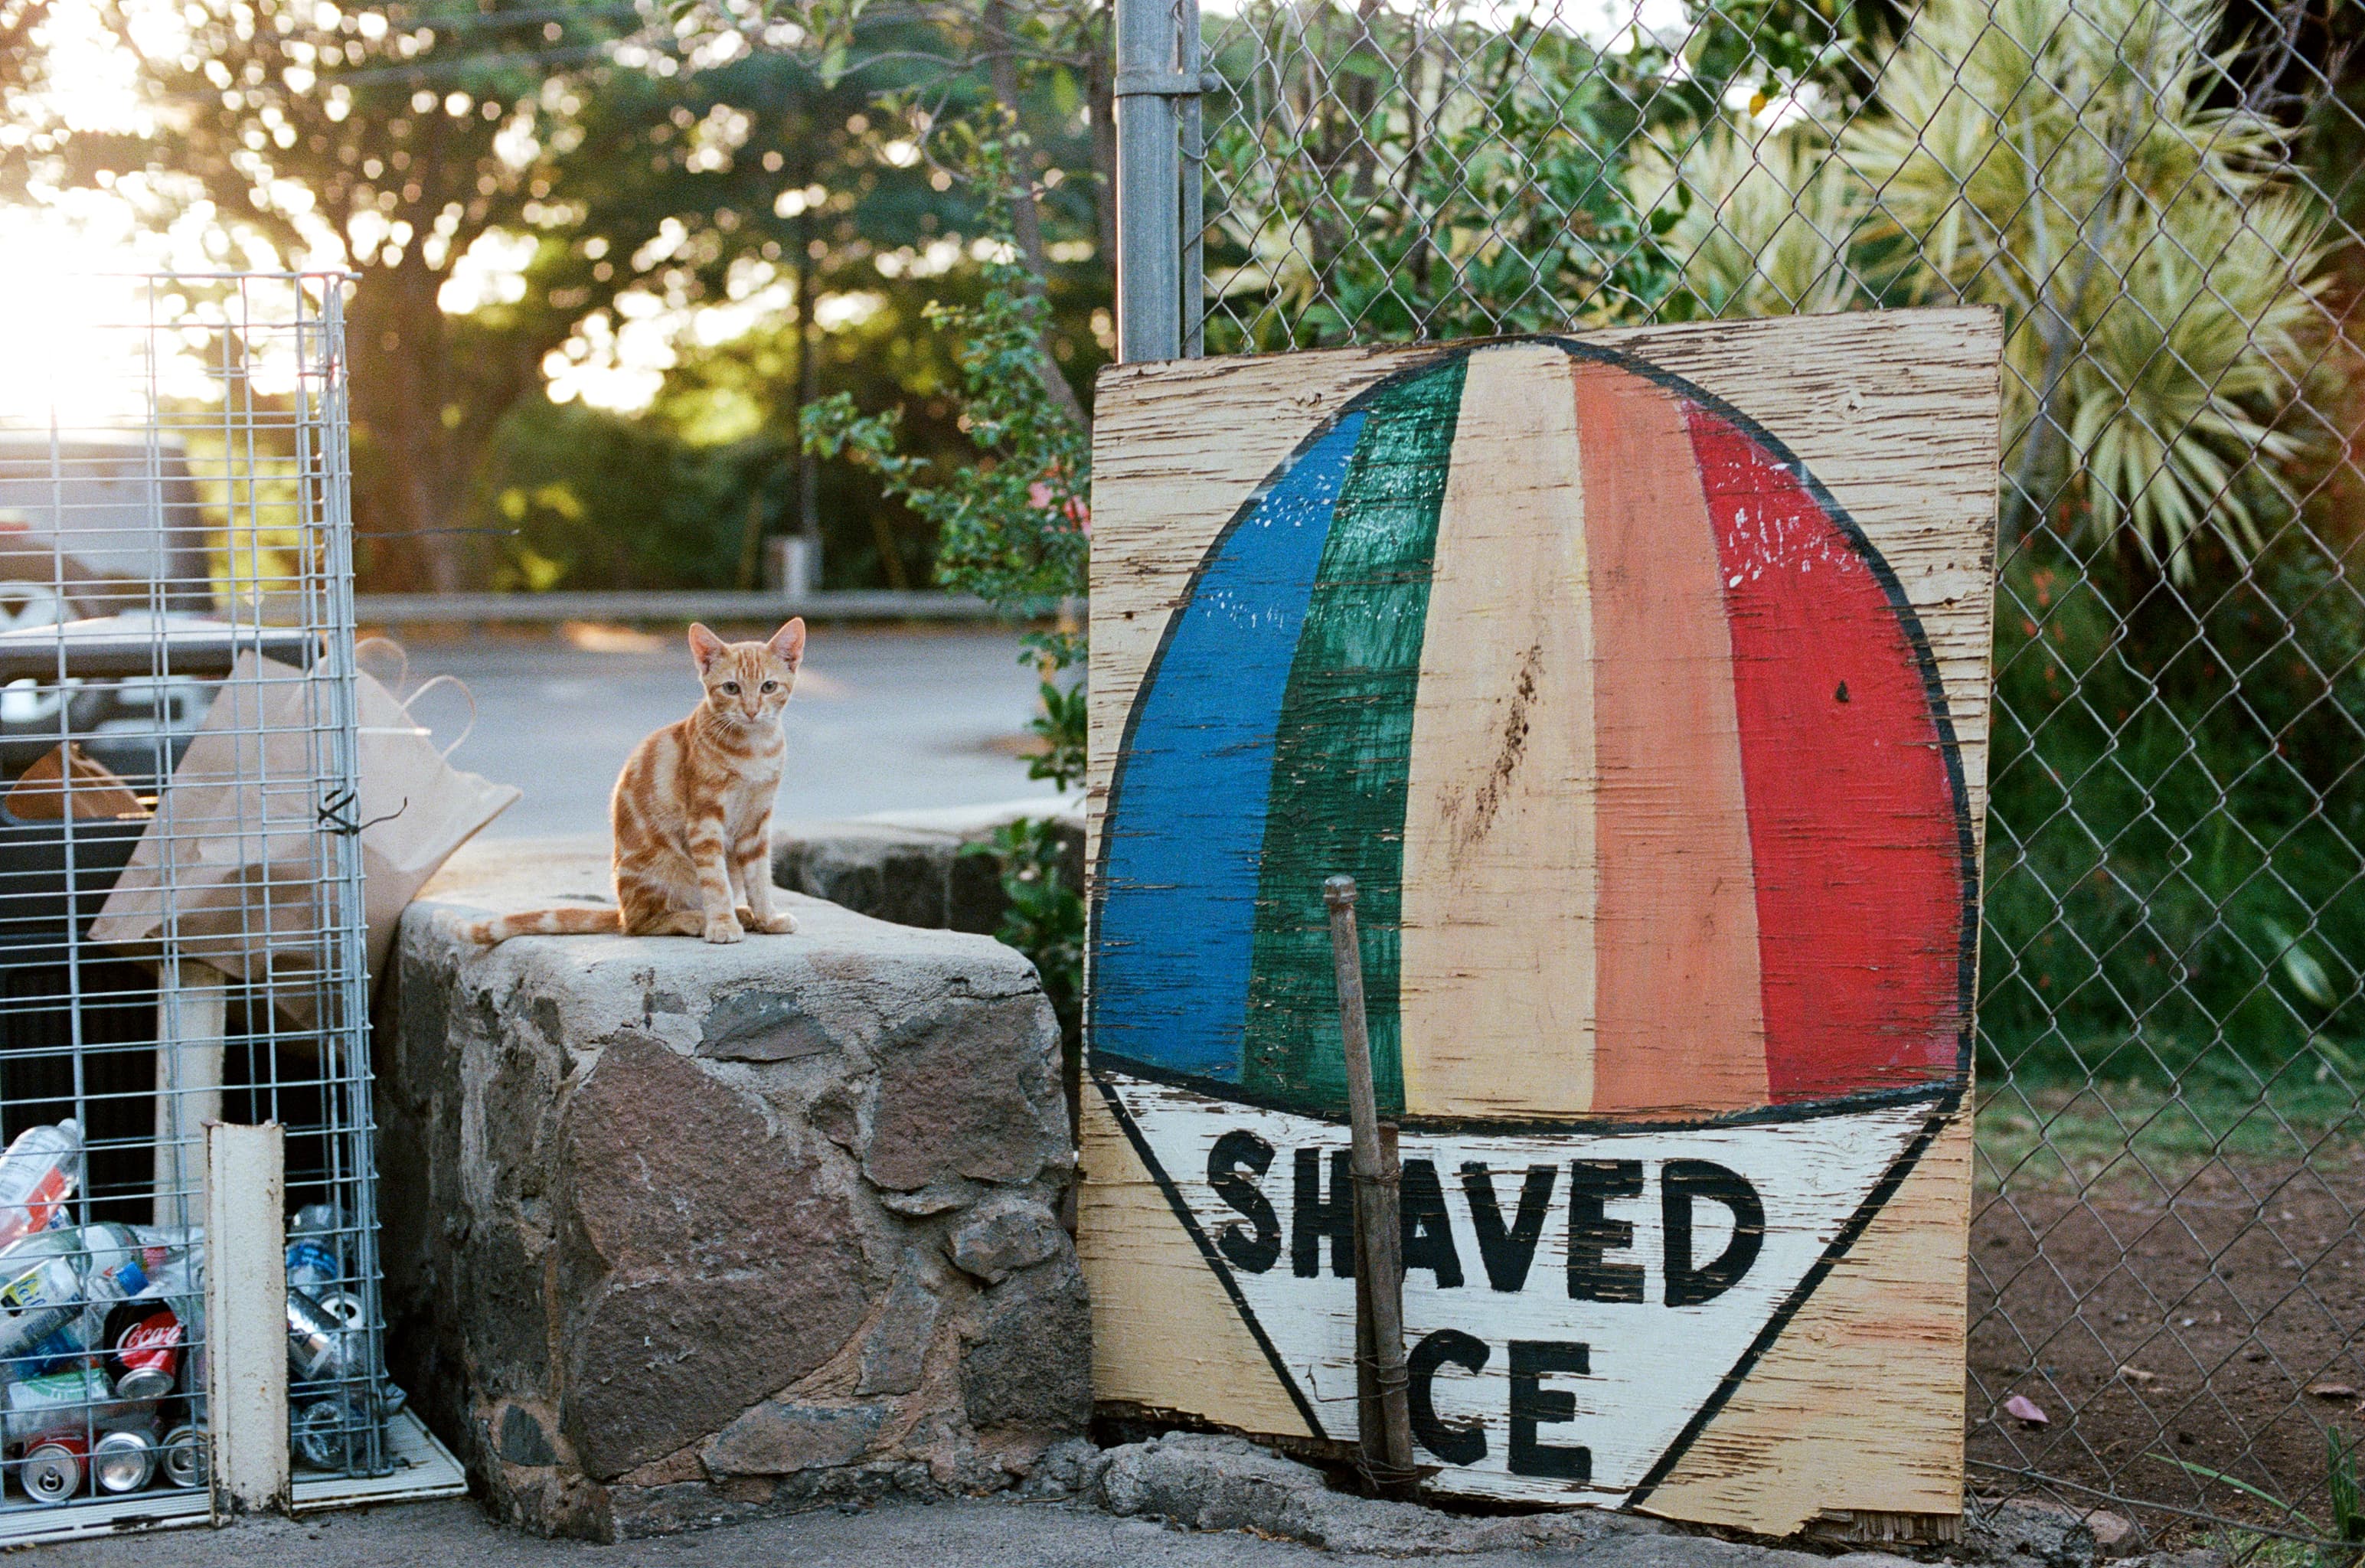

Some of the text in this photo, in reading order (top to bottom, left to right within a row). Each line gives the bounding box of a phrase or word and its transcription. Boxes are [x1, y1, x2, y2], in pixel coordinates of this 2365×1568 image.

[1207, 1129, 1765, 1307] SHAVED
[116, 1321, 183, 1357] Coca-C
[1404, 1328, 1592, 1481] CE
